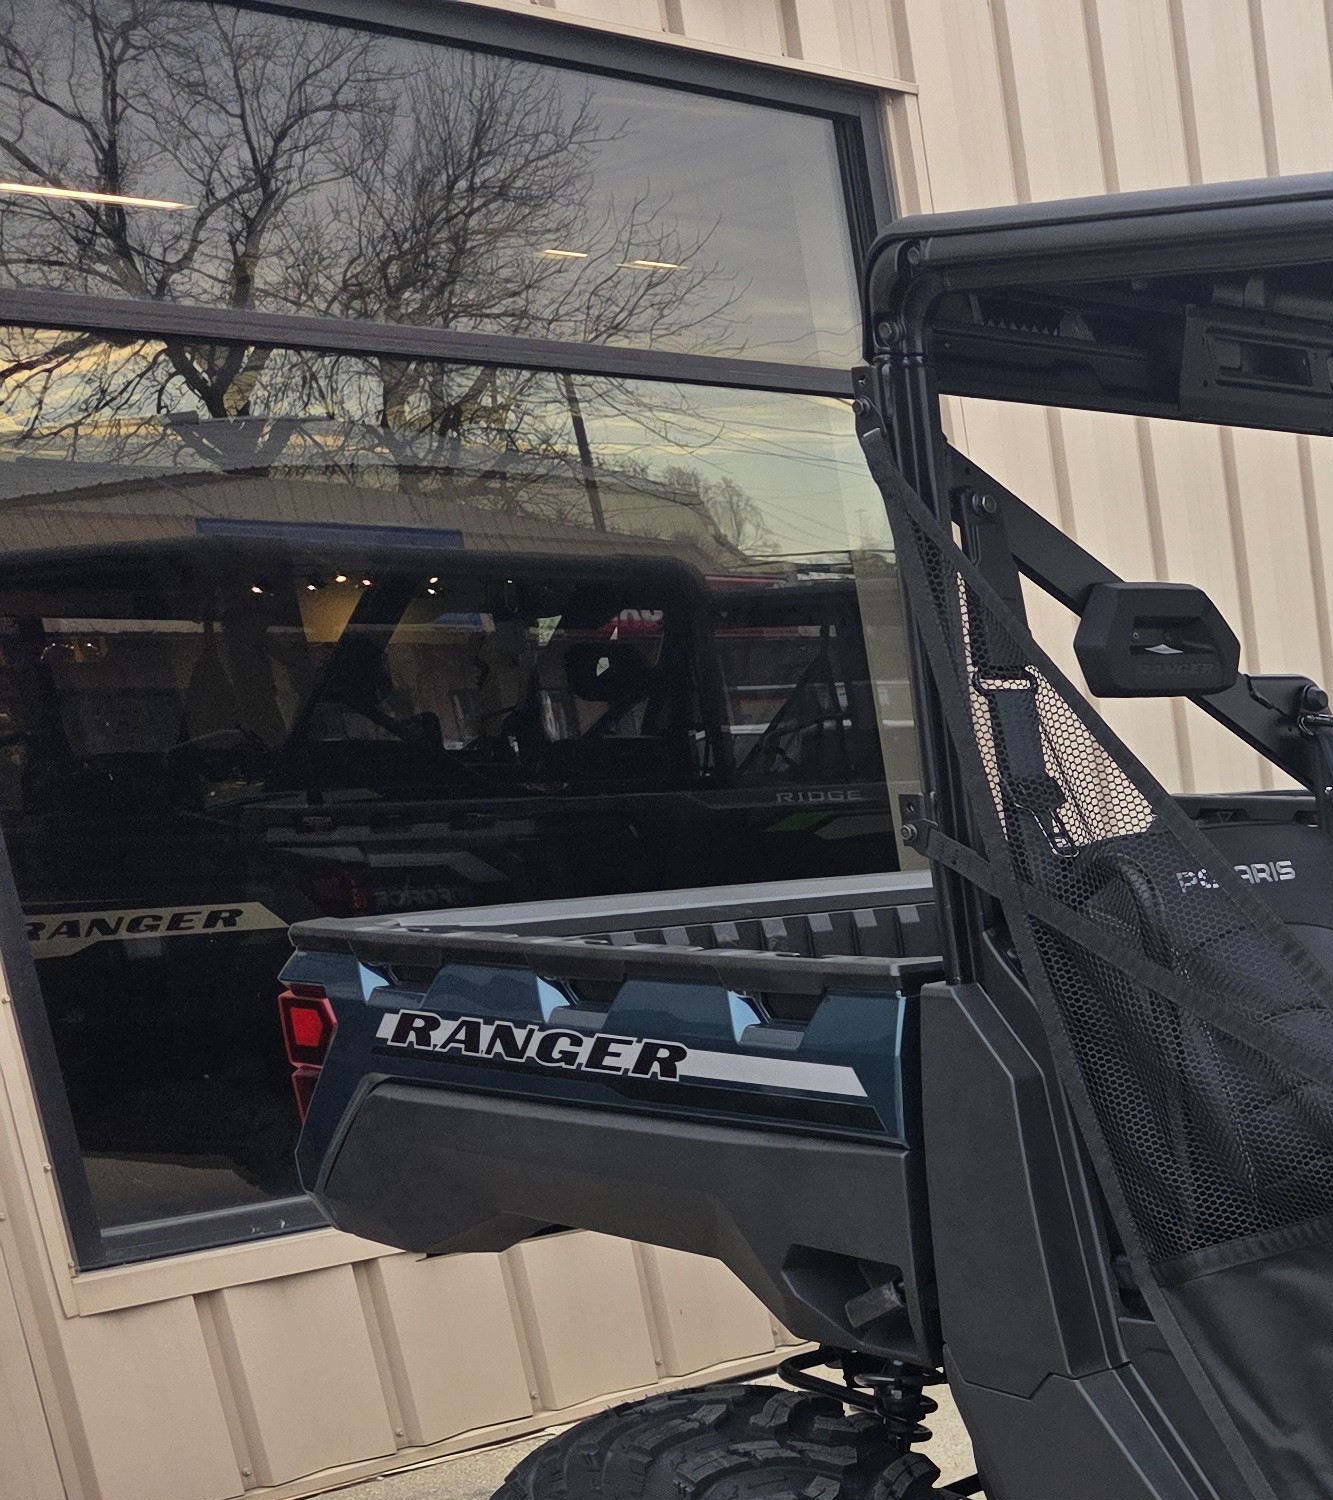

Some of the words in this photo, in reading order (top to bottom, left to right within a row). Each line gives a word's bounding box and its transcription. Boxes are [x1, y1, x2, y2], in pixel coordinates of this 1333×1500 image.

[775, 790, 864, 803] RIDGE
[1175, 860, 1296, 894] POARIS
[387, 1009, 687, 1081] RANGER
